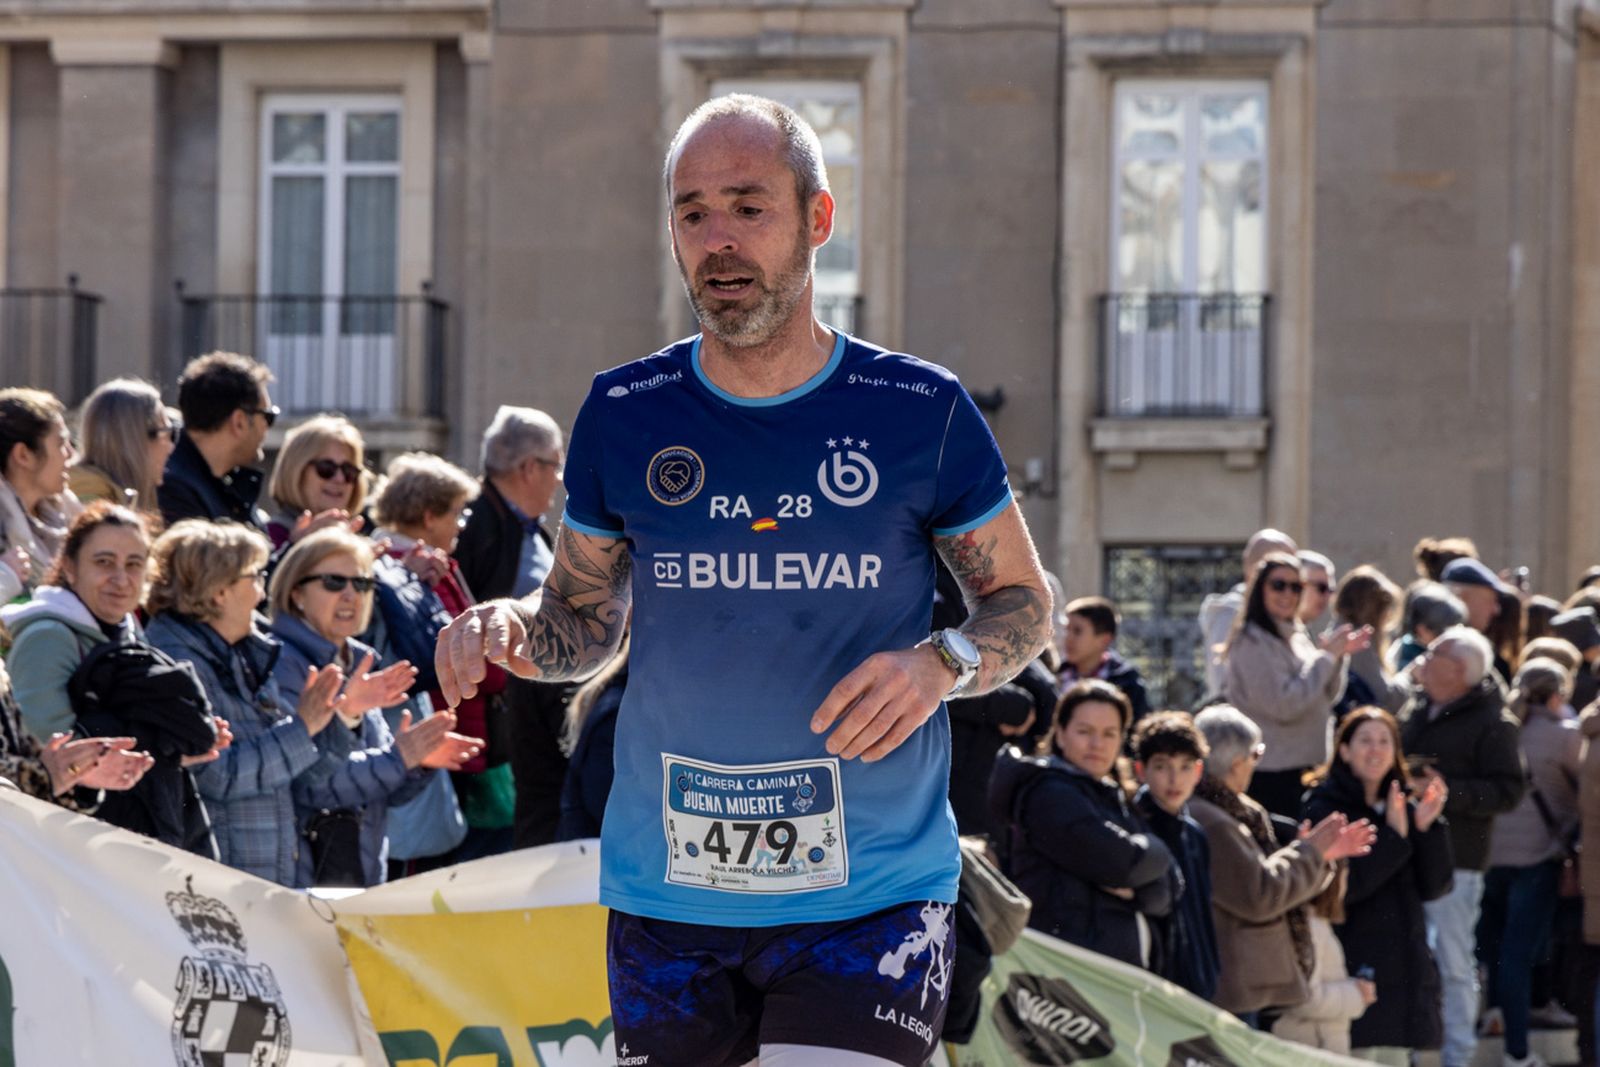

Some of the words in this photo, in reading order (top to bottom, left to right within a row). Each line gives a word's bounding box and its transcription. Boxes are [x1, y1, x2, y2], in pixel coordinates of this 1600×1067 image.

[709, 495, 752, 519] RA
[777, 494, 813, 518] 28
[654, 561, 682, 580] CD
[688, 552, 882, 590] BULEVAR
[696, 773, 744, 791] CARRERA
[747, 772, 812, 791] CAMINATA
[684, 791, 723, 814] BUENA
[726, 795, 785, 815] MUERTE
[703, 820, 798, 865] 479
[874, 1004, 897, 1024] LA
[899, 1012, 934, 1047] LEGIÓ
